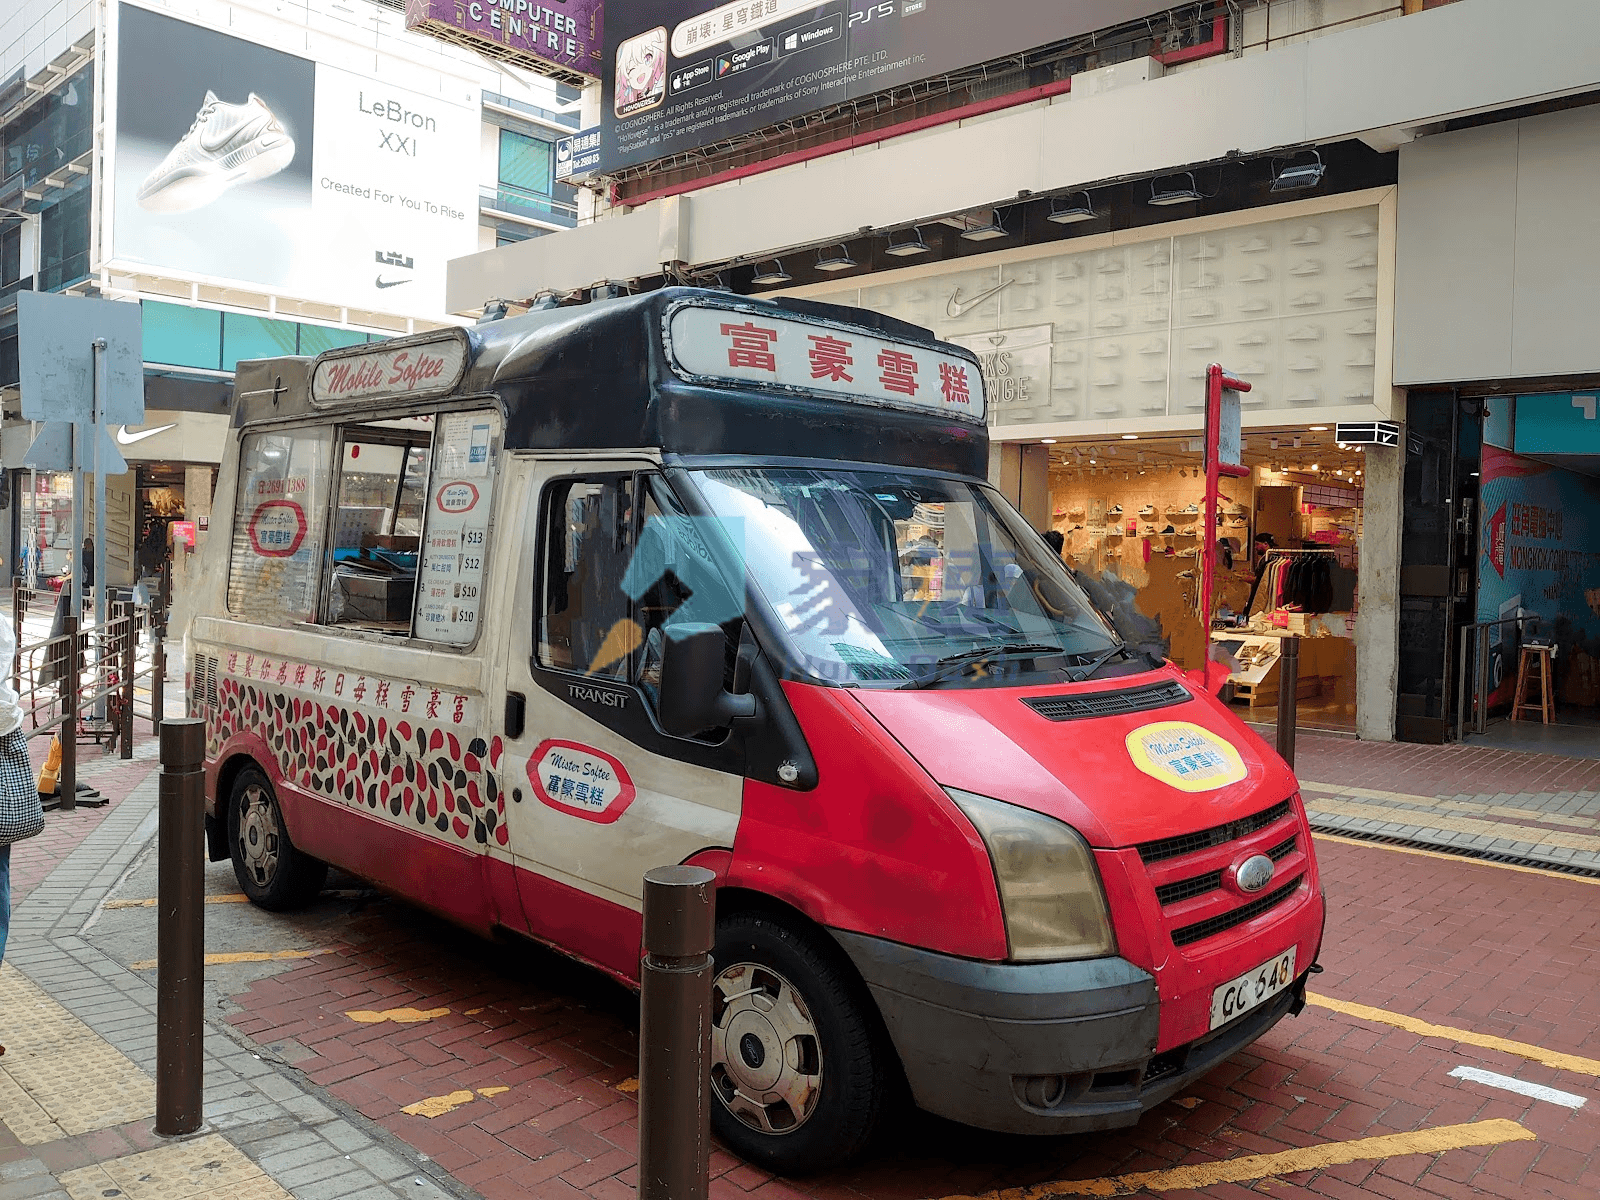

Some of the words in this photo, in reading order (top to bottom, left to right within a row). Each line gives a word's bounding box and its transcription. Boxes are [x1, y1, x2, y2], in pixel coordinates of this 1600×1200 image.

[486, 0, 577, 36] MPUTER
[848, 1, 893, 28] PS5
[905, 2, 923, 13] STORE
[469, 2, 577, 57] CENTRE
[800, 25, 834, 43] Windows
[731, 48, 756, 63] Google
[756, 44, 770, 55] Play
[682, 71, 695, 81] App
[694, 66, 710, 76] Store
[649, 133, 660, 144] and
[675, 126, 686, 136] are
[685, 118, 714, 133] registered
[715, 107, 749, 124] trademarks
[749, 105, 757, 113] or
[757, 92, 793, 109] trademarks
[794, 87, 802, 99] of
[802, 83, 820, 97] Sony
[820, 74, 857, 91] Interactive
[858, 58, 911, 80] Entertainment
[664, 113, 695, 129] trademark
[695, 105, 717, 118] and/or
[717, 95, 750, 112] registered
[750, 82, 785, 101] trademark
[785, 78, 795, 89] of
[794, 61, 853, 86] COGNOSPHERE
[853, 56, 870, 69] PTE.
[871, 50, 889, 63] LTD.
[666, 105, 675, 116] All
[675, 101, 694, 115] Rights
[694, 90, 723, 107] Reserved.
[359, 91, 436, 133] LeBron
[378, 129, 416, 157] XXI
[320, 177, 371, 199] Created
[374, 189, 394, 204] For
[398, 194, 421, 211] You
[424, 201, 438, 214] To
[440, 205, 465, 221] Rise
[328, 360, 384, 395] Mobile
[388, 351, 444, 391] Softee
[719, 321, 971, 405] 富豪雪糕
[987, 375, 1031, 403] NGE
[287, 477, 306, 494] 1388
[260, 529, 291, 544] 富豪雪糕
[467, 530, 483, 544] $13
[464, 558, 480, 569] $12
[462, 584, 477, 598] $10
[458, 610, 474, 622] $10
[568, 684, 631, 709] TRANSIT
[1149, 742, 1182, 756] Mister
[550, 752, 581, 774] Mister
[582, 761, 611, 782] Softee
[548, 774, 605, 806] 富豪雪糕
[1222, 978, 1249, 1018] GC
